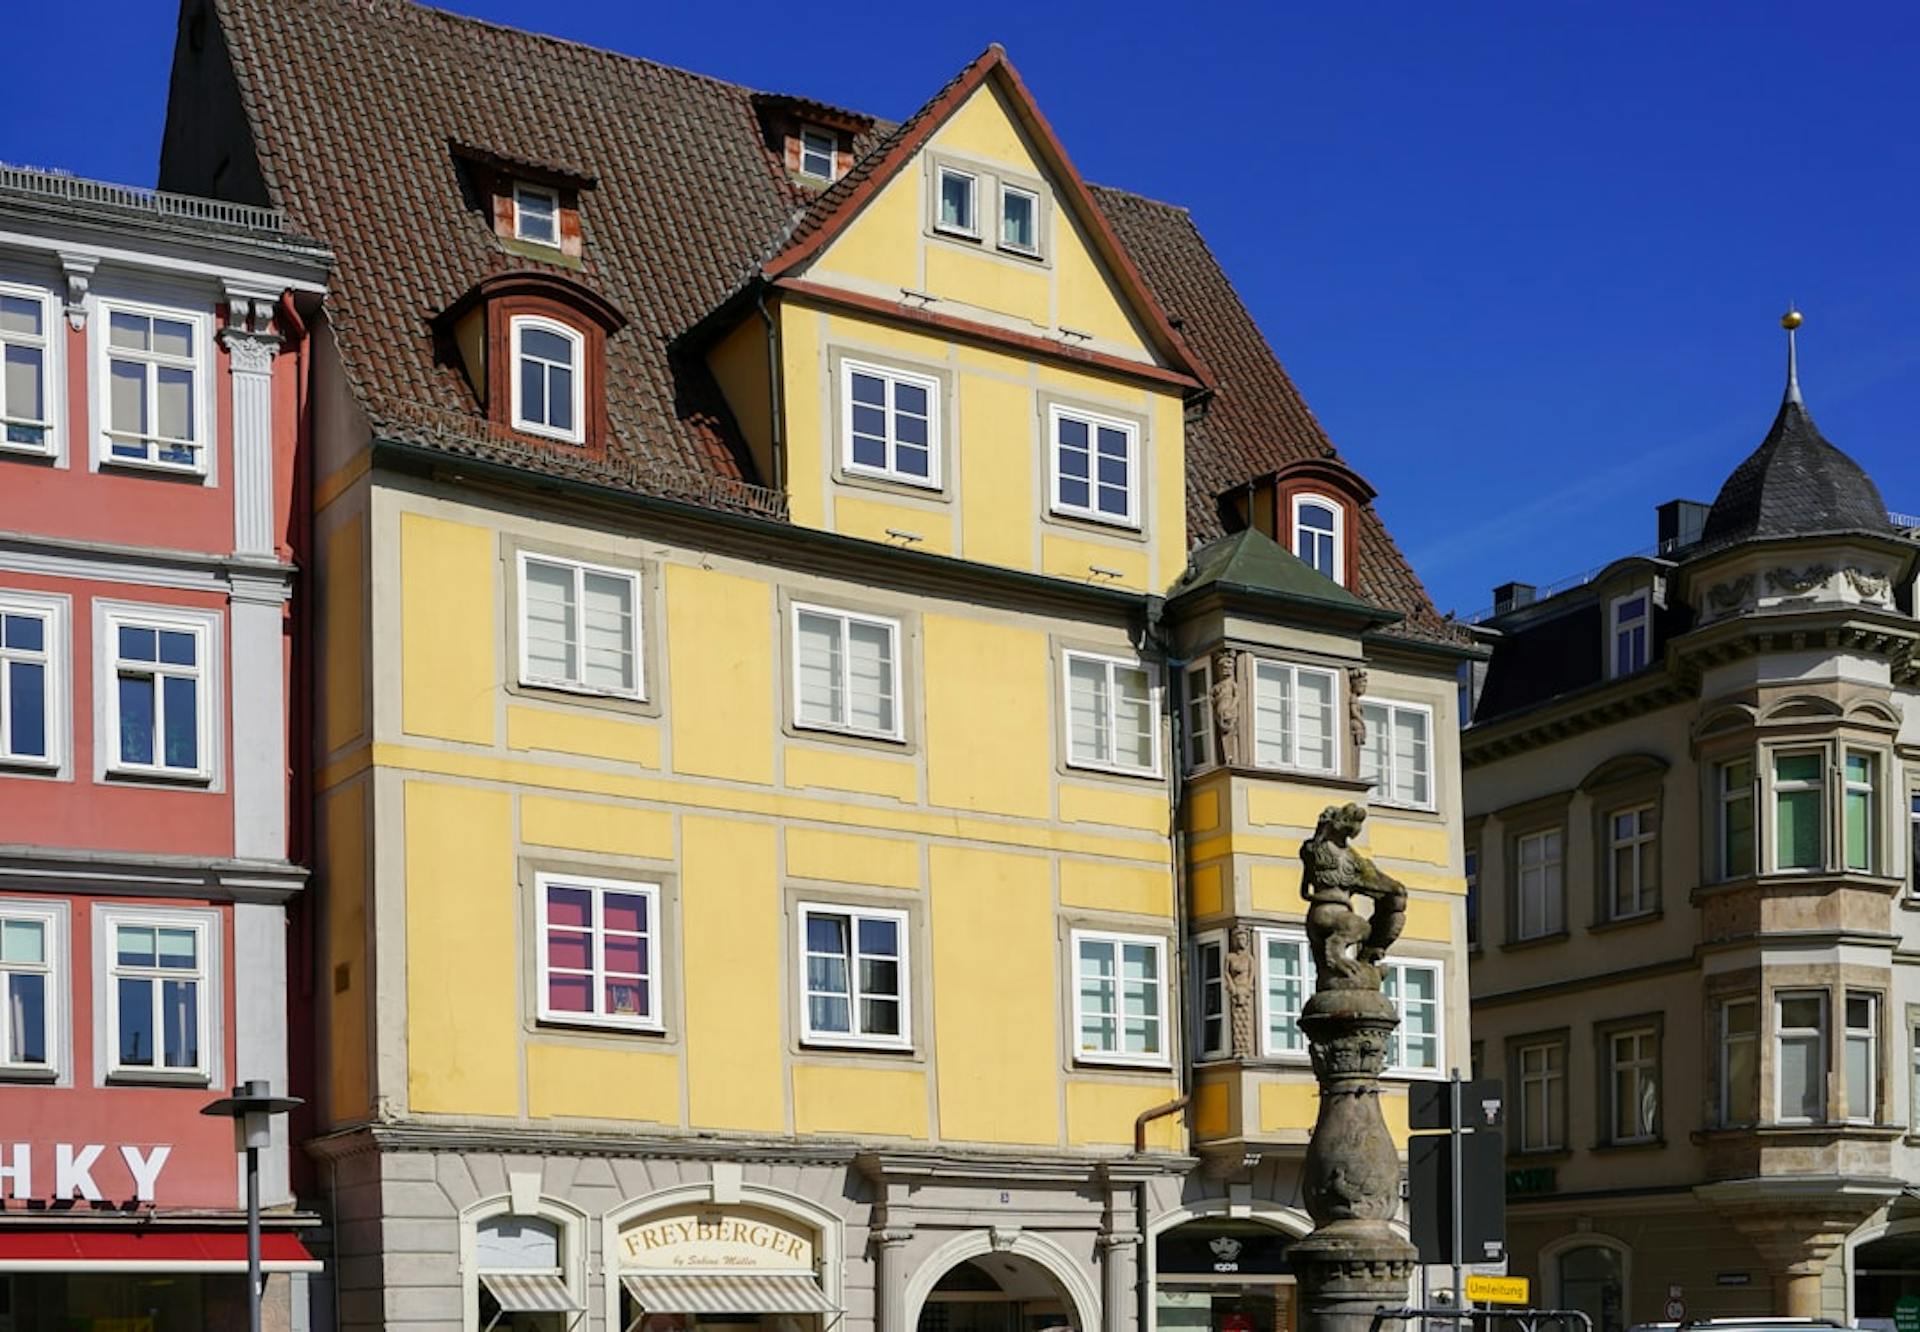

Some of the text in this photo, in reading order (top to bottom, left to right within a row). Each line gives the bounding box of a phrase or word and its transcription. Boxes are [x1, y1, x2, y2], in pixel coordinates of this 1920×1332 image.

[625, 1222, 803, 1262] FREYBERGER
[673, 1255, 684, 1266] by
[1470, 1280, 1524, 1299] Umleitung
